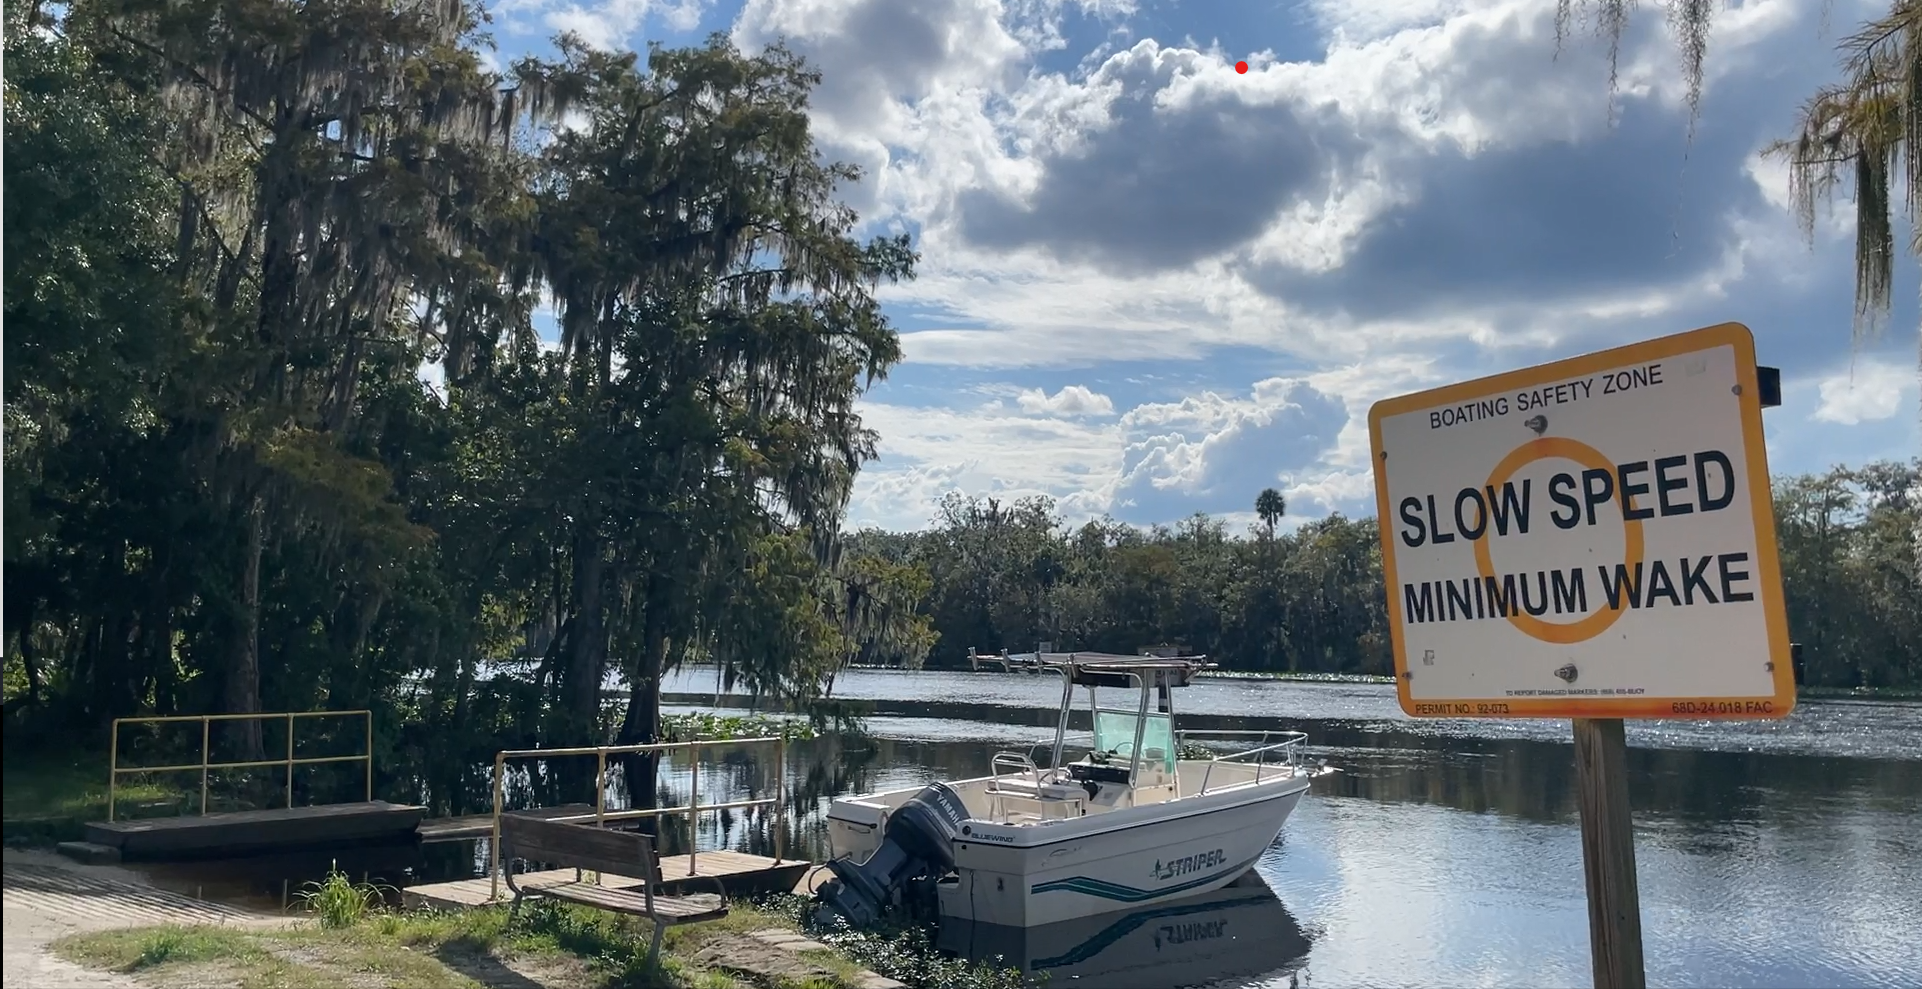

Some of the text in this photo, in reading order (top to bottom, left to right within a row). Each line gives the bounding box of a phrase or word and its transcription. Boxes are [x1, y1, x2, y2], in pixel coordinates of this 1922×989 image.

[1429, 363, 1664, 430] BOATING SAFETY ZONE
[1399, 450, 1736, 548] SLOW SPEED
[1405, 552, 1755, 624] MINIMUM WAKE
[1415, 703, 1452, 714] PERMIT
[1477, 703, 1510, 714] 92-073
[1672, 702, 1773, 714] 68D-24.018 FAC
[1159, 848, 1227, 881] STRIPER
